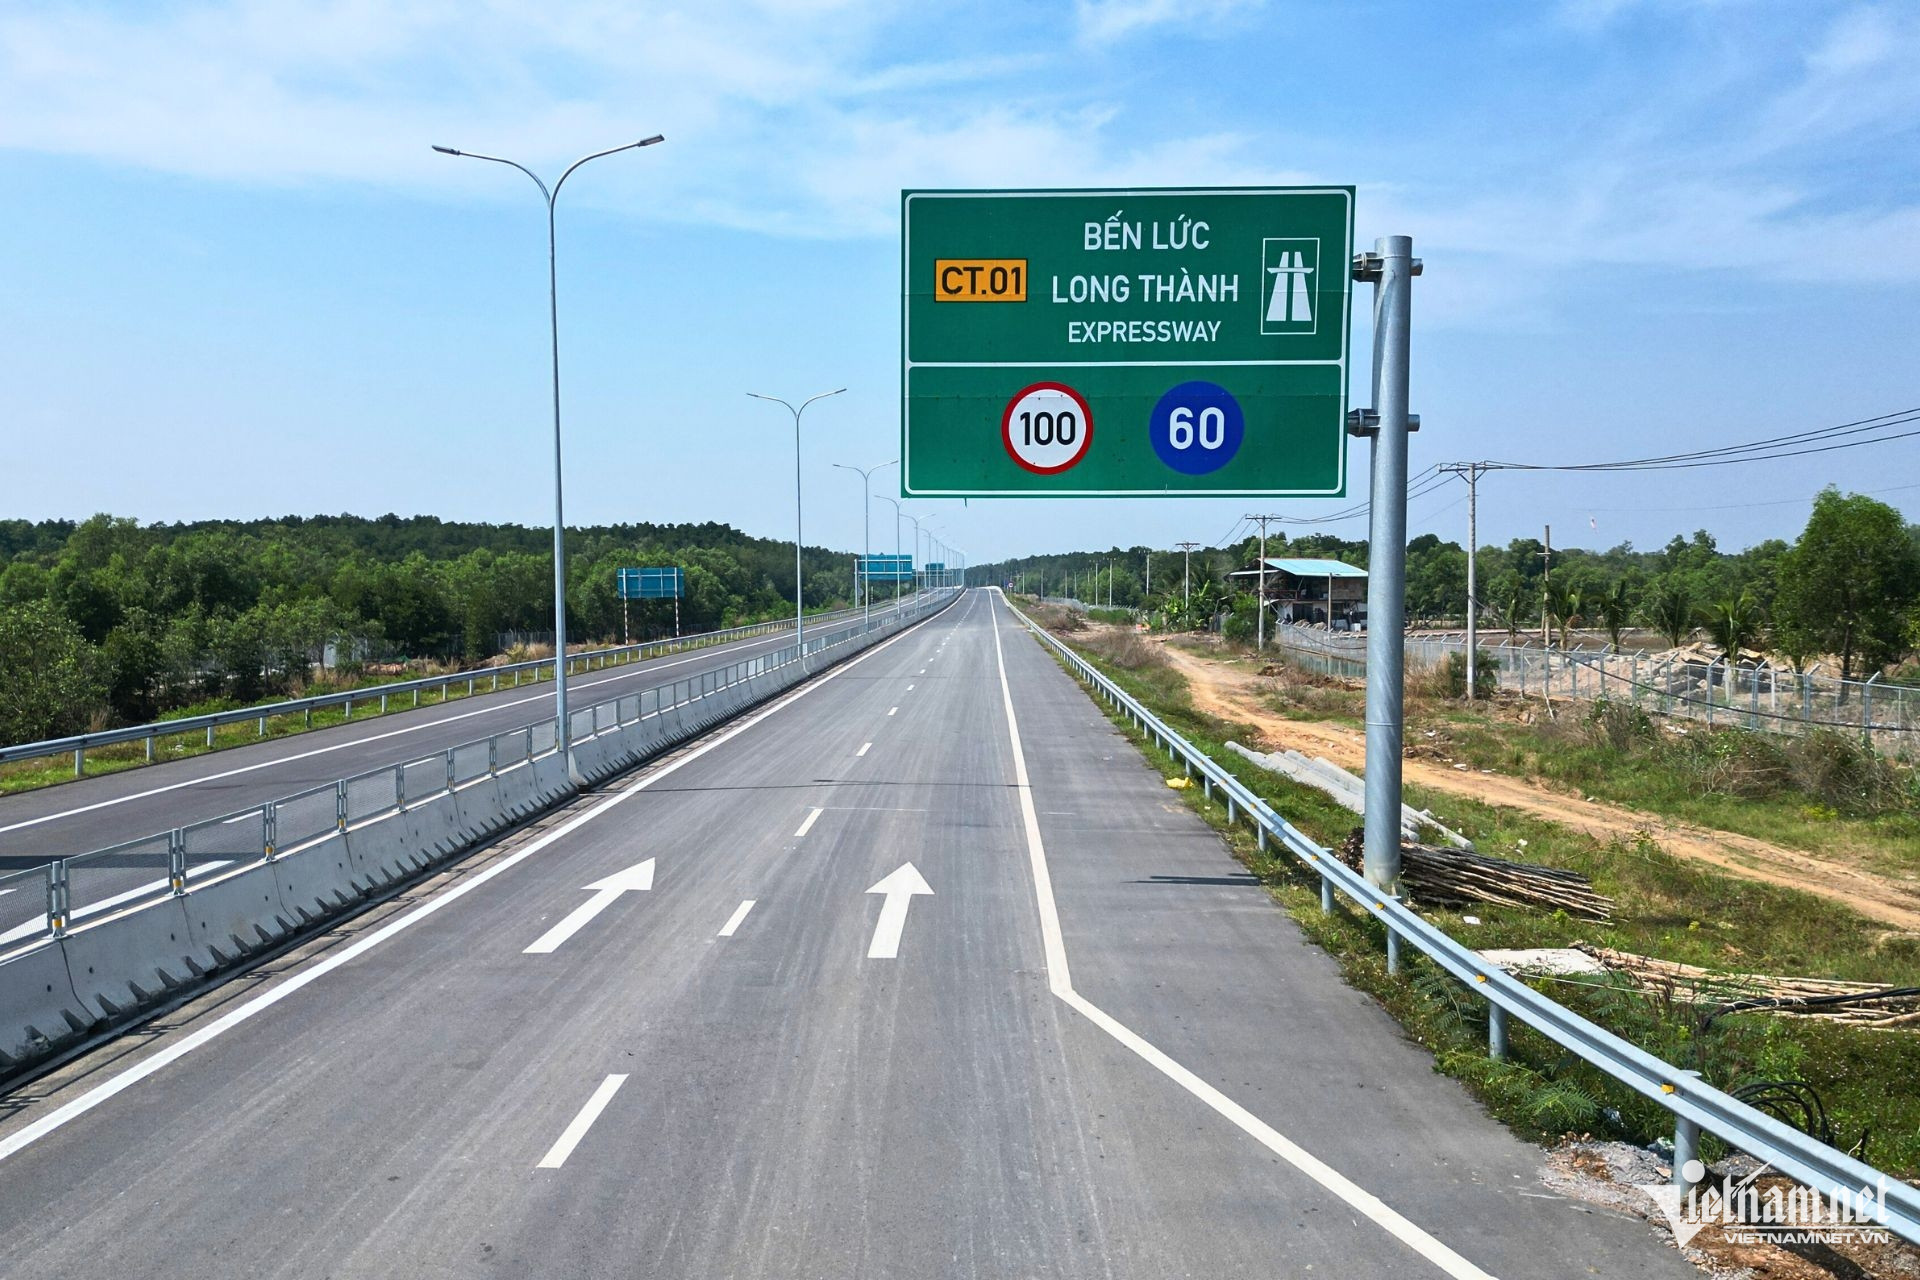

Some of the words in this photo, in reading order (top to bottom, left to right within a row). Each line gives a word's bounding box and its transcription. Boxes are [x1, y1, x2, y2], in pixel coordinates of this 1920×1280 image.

[1084, 210, 1142, 251] BẾN
[1152, 214, 1210, 250] LỨC
[941, 266, 1021, 295] CT.01
[1052, 274, 1130, 303] LONG
[1138, 267, 1239, 303] THÀNH
[1068, 320, 1221, 343] EXPRESSWAY
[1019, 411, 1076, 445] 100
[1169, 406, 1225, 450] 60
